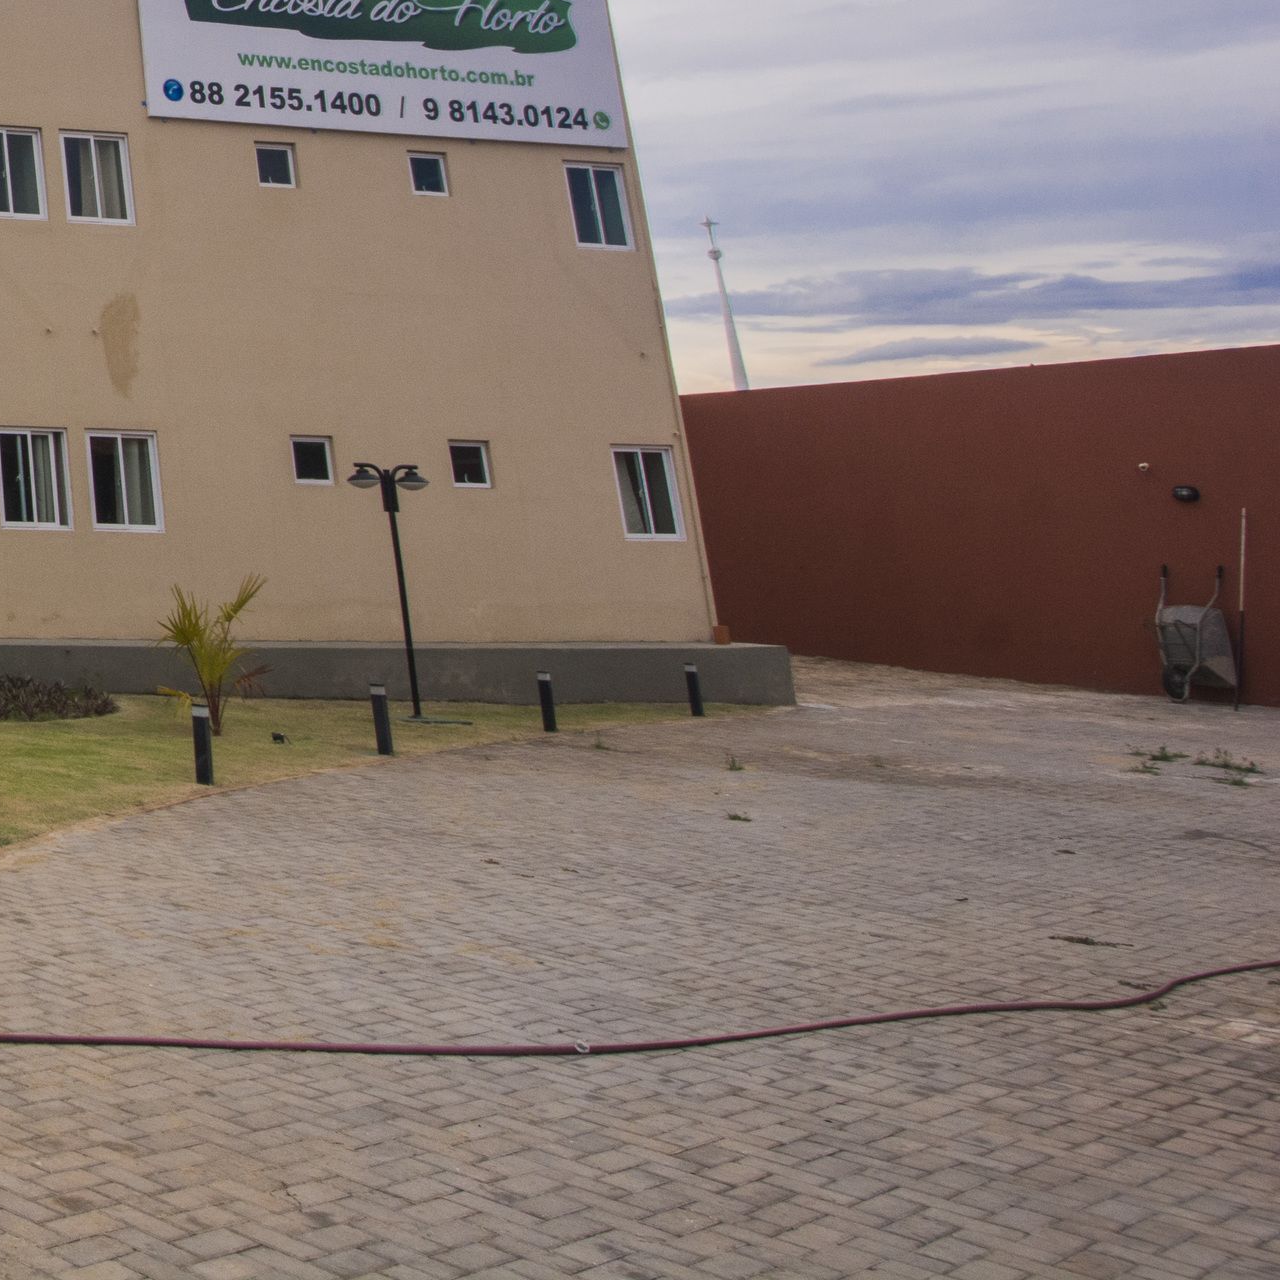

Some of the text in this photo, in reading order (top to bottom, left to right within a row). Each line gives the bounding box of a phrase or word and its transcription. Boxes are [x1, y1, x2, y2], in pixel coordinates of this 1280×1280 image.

[238, 53, 534, 87] www.encostadohorto.com.br
[189, 80, 224, 105] 88
[234, 85, 381, 117] 2155.1400
[422, 98, 439, 121] 9
[449, 98, 589, 130] 8143.0124
